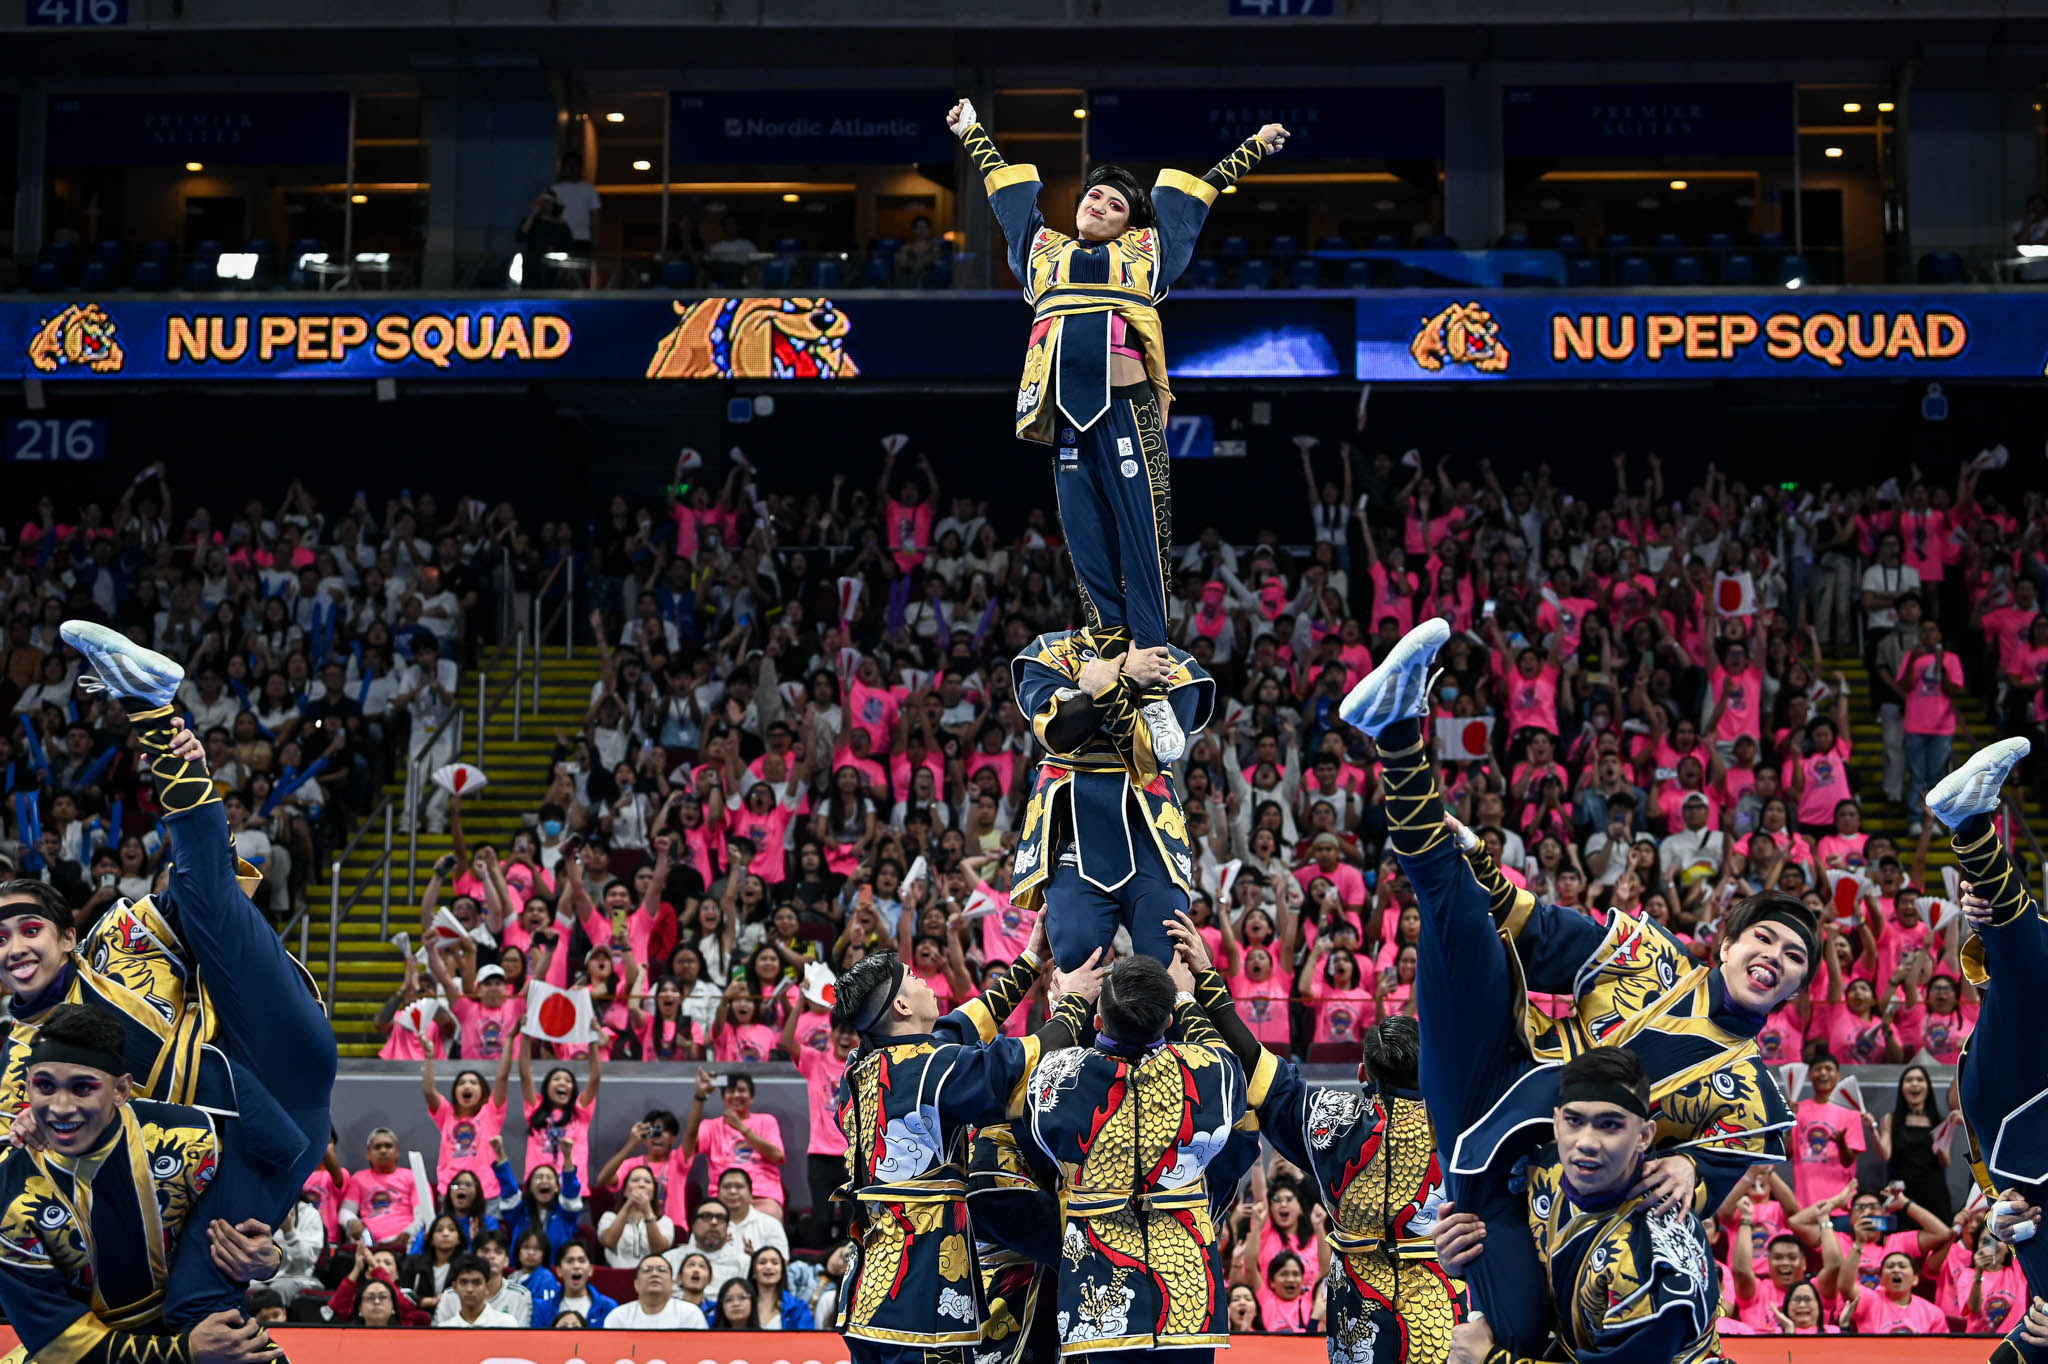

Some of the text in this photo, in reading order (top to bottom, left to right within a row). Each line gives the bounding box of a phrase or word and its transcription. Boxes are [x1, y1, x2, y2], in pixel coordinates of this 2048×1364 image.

[144, 112, 254, 128] PREMIER
[1209, 106, 1319, 122] PREMIER
[1592, 104, 1703, 120] PREMIER
[746, 118, 918, 136] Nordic Atlantic
[1218, 124, 1310, 141] SUS
[1602, 121, 1695, 136] SUITES
[152, 129, 242, 145] SUITES
[167, 315, 571, 368] NU PEP SQUAD
[1552, 313, 1967, 366] NU PEP SQUAD
[15, 418, 95, 461] 216
